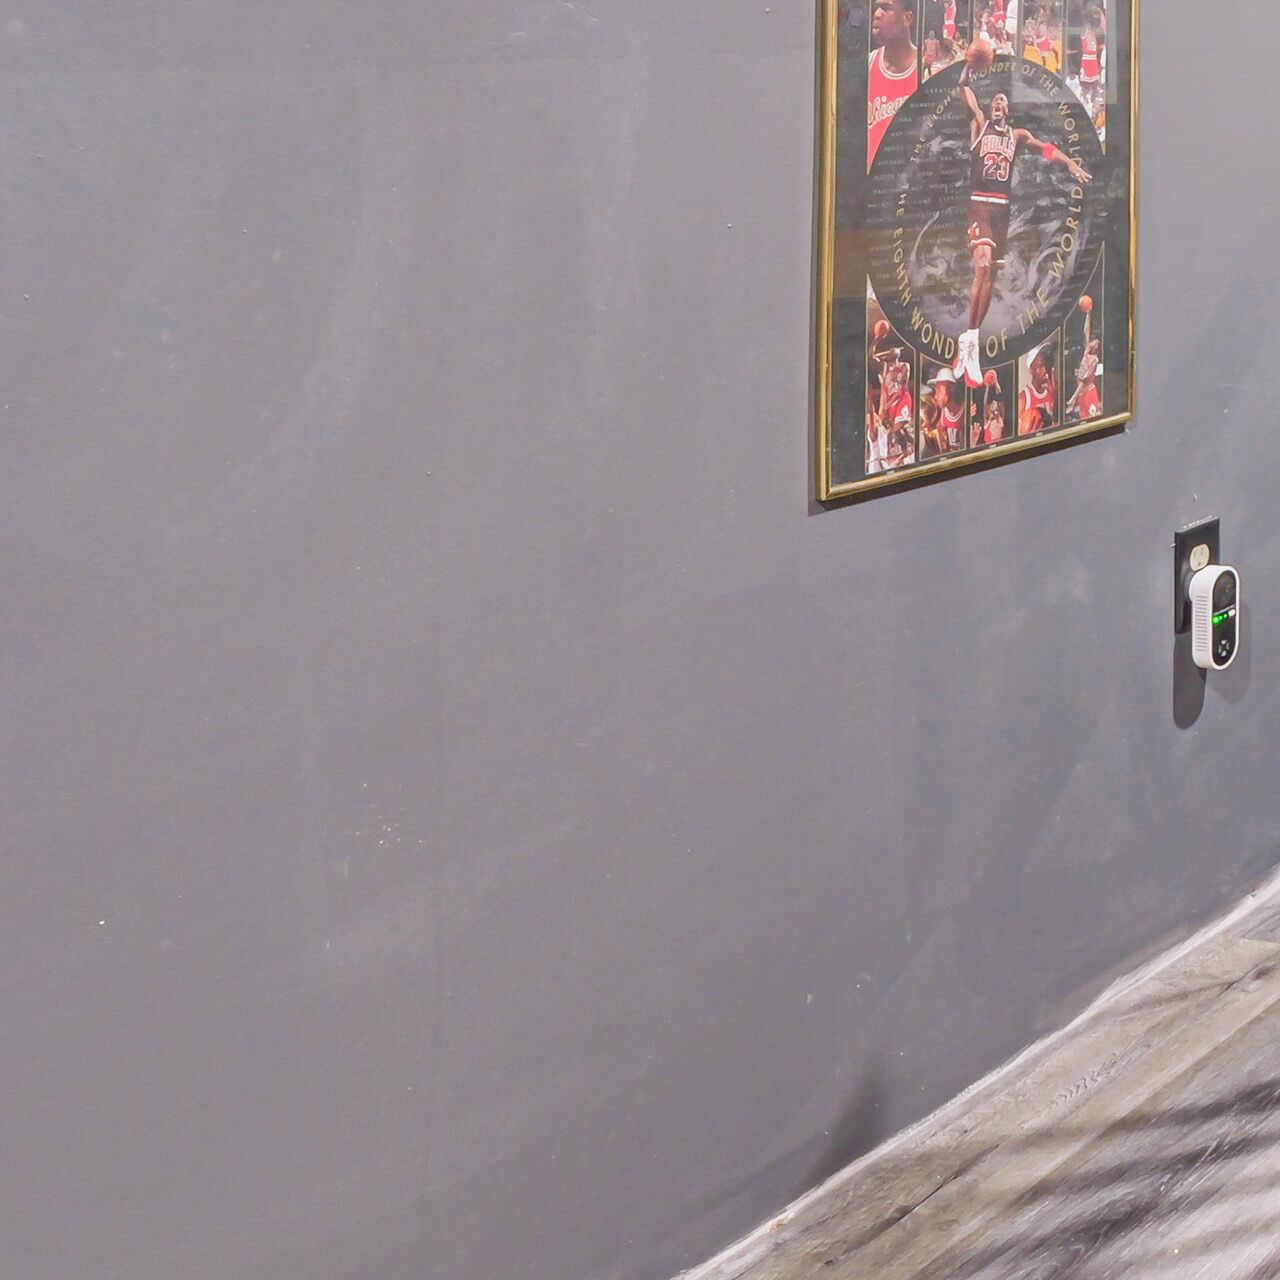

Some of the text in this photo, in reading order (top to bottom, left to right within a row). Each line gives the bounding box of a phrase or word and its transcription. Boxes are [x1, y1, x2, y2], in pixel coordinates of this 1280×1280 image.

[971, 61, 1017, 82] WONDER
[1021, 65, 1036, 78] OF
[1039, 72, 1060, 97] THE
[1058, 99, 1082, 169] WORLD
[979, 134, 1017, 162] BULLS
[983, 154, 1011, 182] 23
[893, 227, 913, 307] EIGHTH
[910, 307, 956, 359] WOND
[986, 330, 1008, 358] OF
[1017, 287, 1049, 334] THE
[1049, 185, 1083, 282] WORLD
